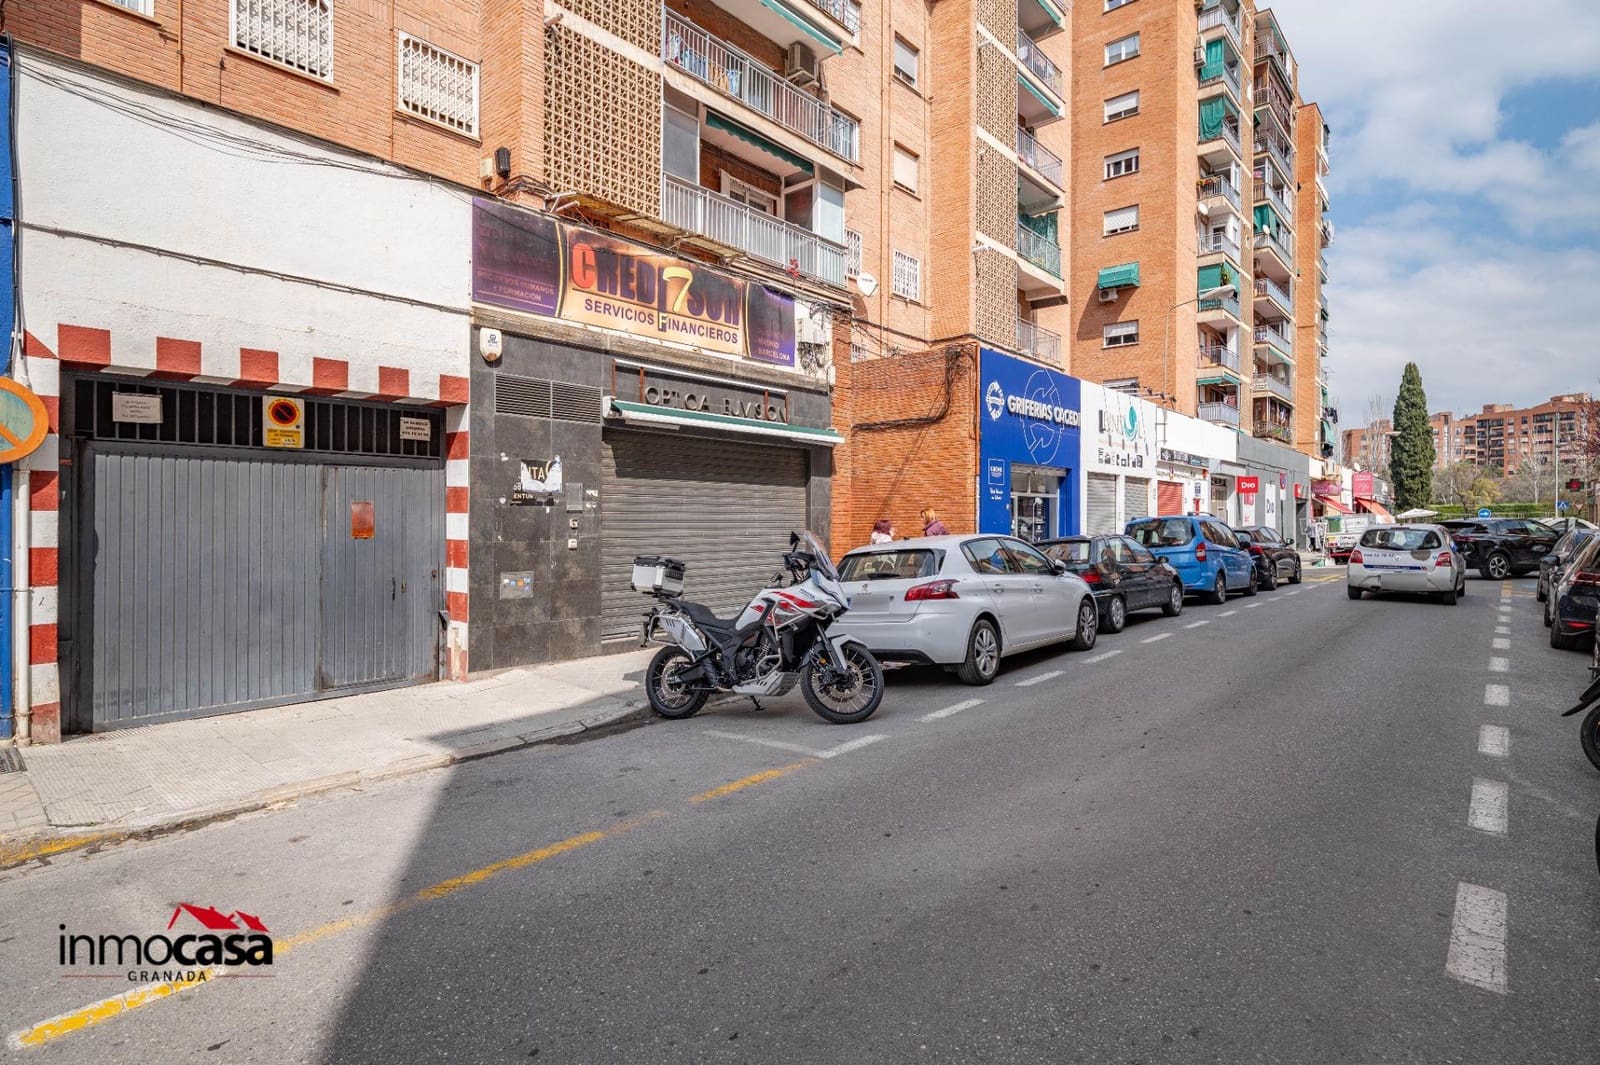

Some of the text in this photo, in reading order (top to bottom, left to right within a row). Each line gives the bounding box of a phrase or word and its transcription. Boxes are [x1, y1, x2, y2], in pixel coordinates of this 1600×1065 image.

[520, 279, 554, 295] HUMANOS
[584, 298, 738, 344] SERVICIOS FINANCIEROS
[757, 347, 791, 361] BARCELONA
[1053, 406, 1080, 426] CACED
